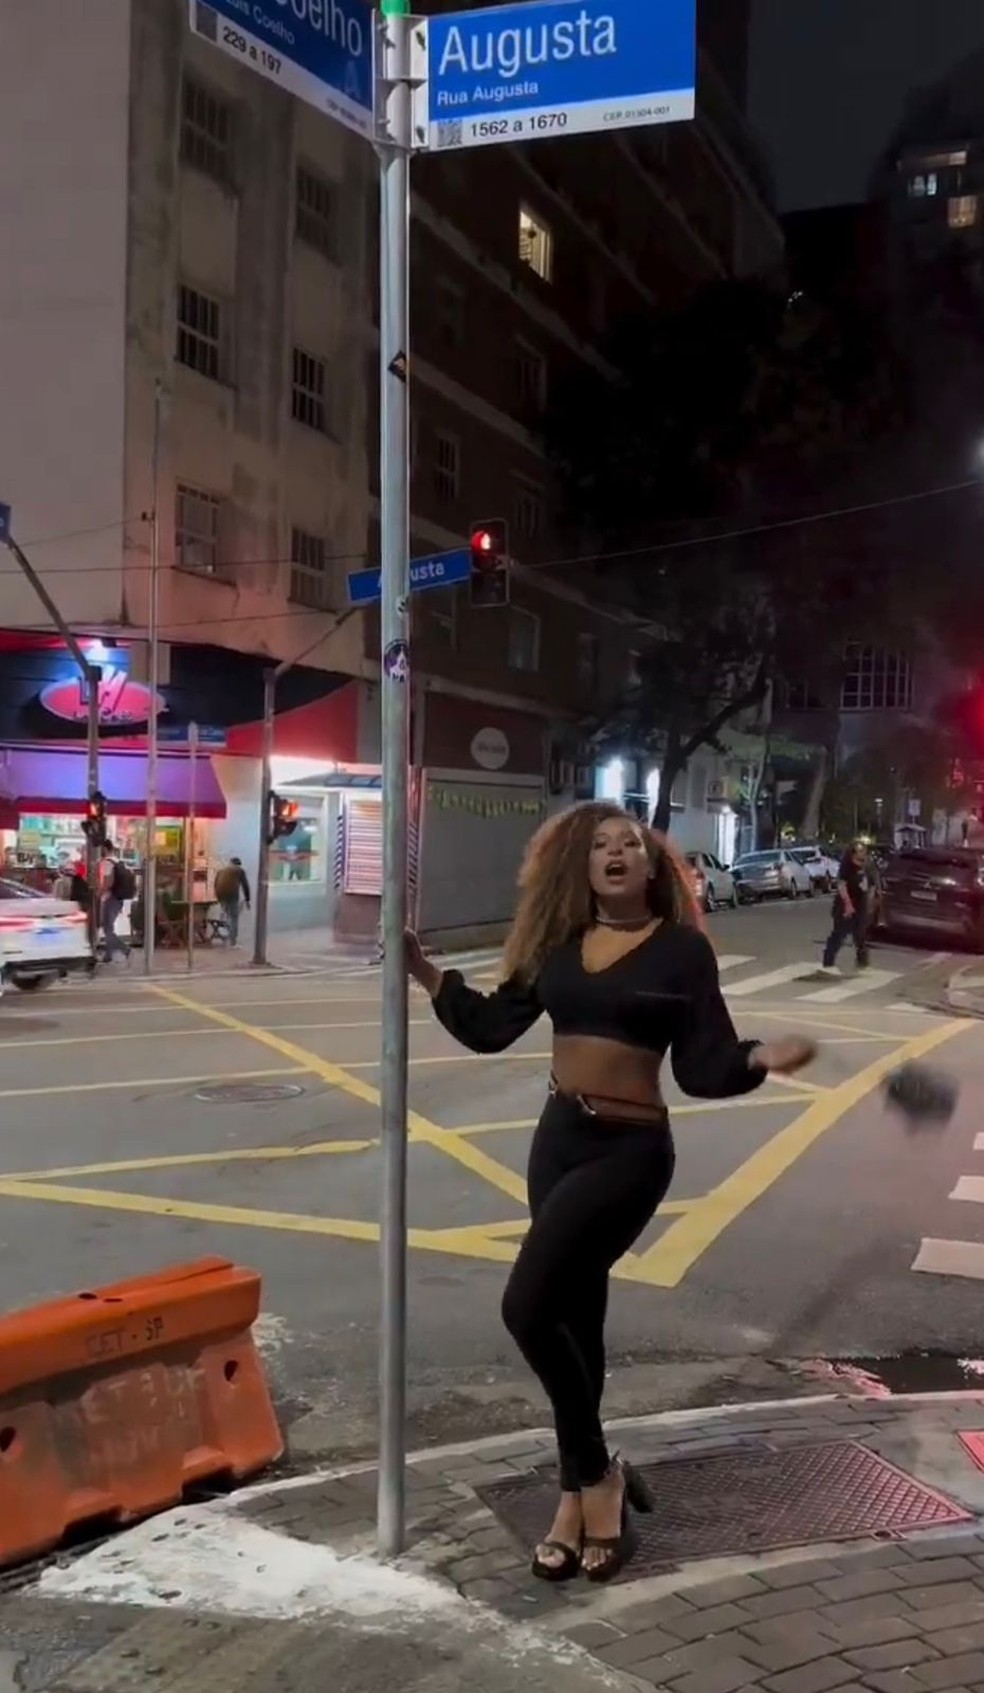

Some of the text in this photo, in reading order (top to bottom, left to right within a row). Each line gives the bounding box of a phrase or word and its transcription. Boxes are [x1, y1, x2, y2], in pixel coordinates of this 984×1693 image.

[253, 6, 295, 44] Coelho
[438, 9, 617, 78] Augusta
[223, 26, 282, 75] 229 a 197
[437, 80, 539, 106] Rua Augusta
[471, 112, 568, 137] 1562 a 1670
